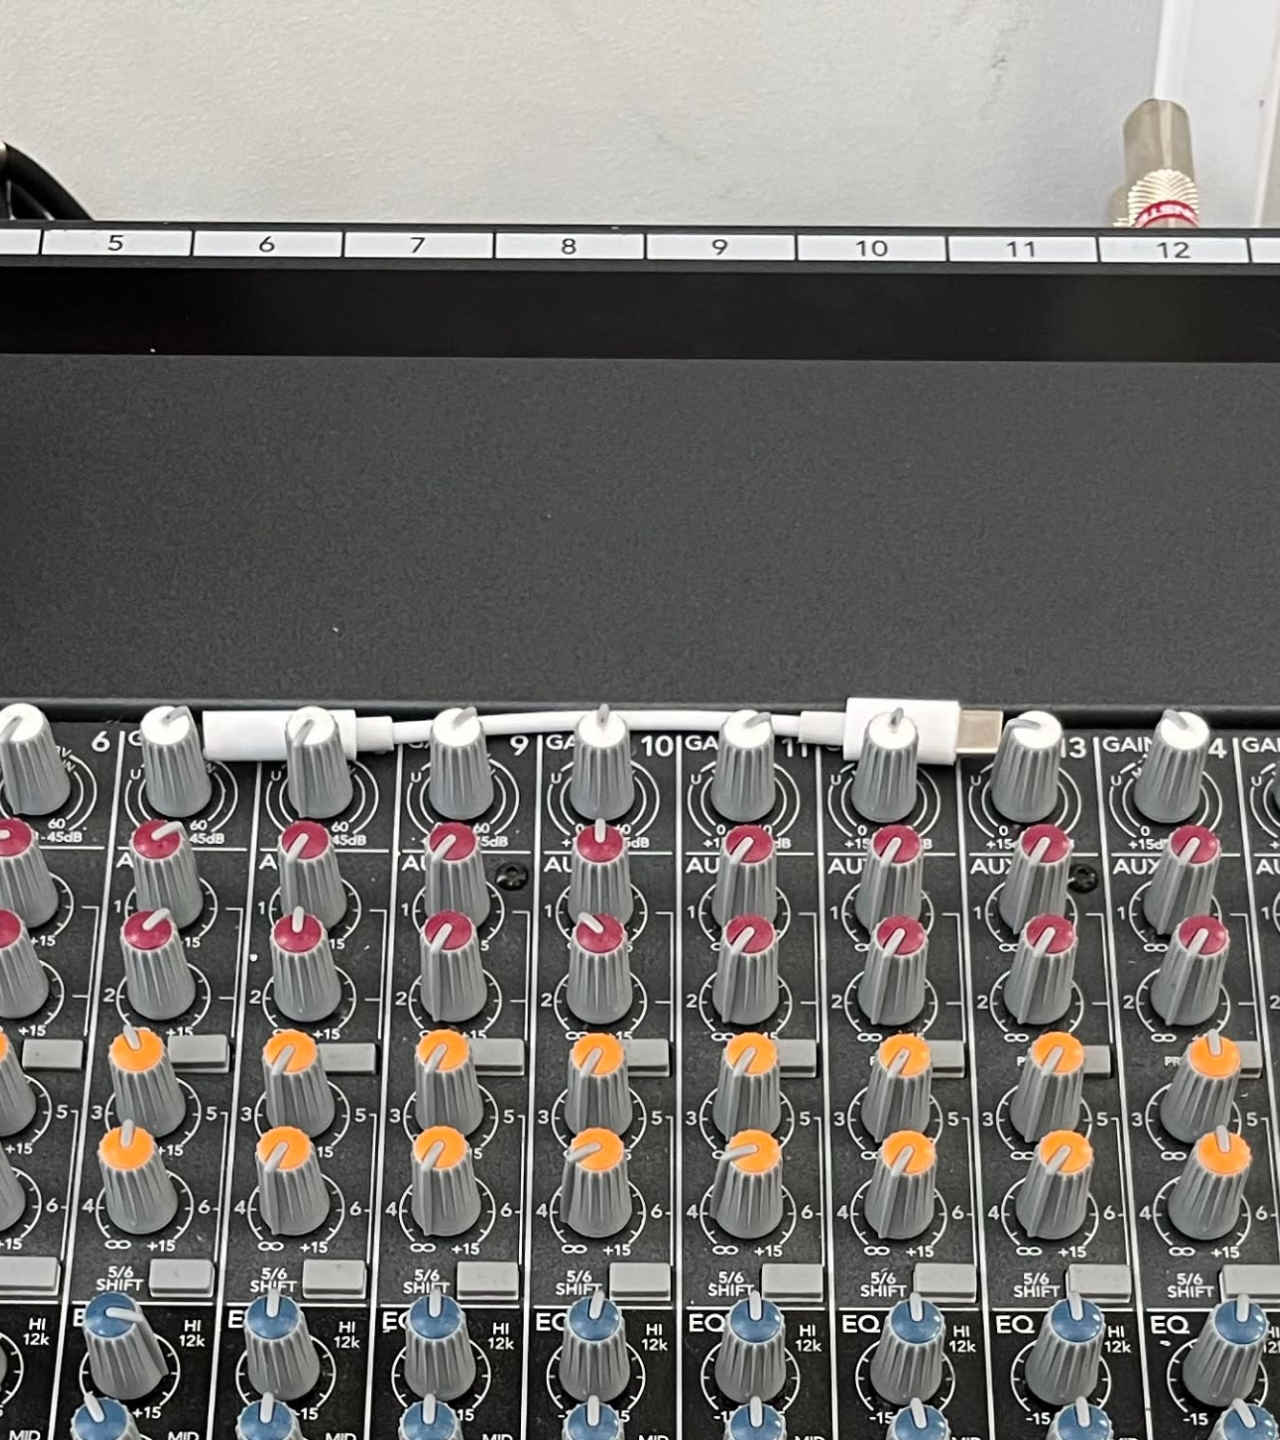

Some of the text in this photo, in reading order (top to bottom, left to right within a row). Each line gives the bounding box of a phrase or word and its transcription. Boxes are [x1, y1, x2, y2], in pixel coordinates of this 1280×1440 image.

[108, 235, 123, 251] 5
[259, 236, 274, 252] 6
[411, 237, 425, 253] 7
[562, 239, 576, 254] 8
[712, 239, 727, 255] 9
[856, 240, 888, 256] 10
[1008, 241, 1034, 257] 11
[1158, 242, 1190, 258] 12
[642, 736, 673, 756] 10
[1151, 1316, 1190, 1334] EQ
